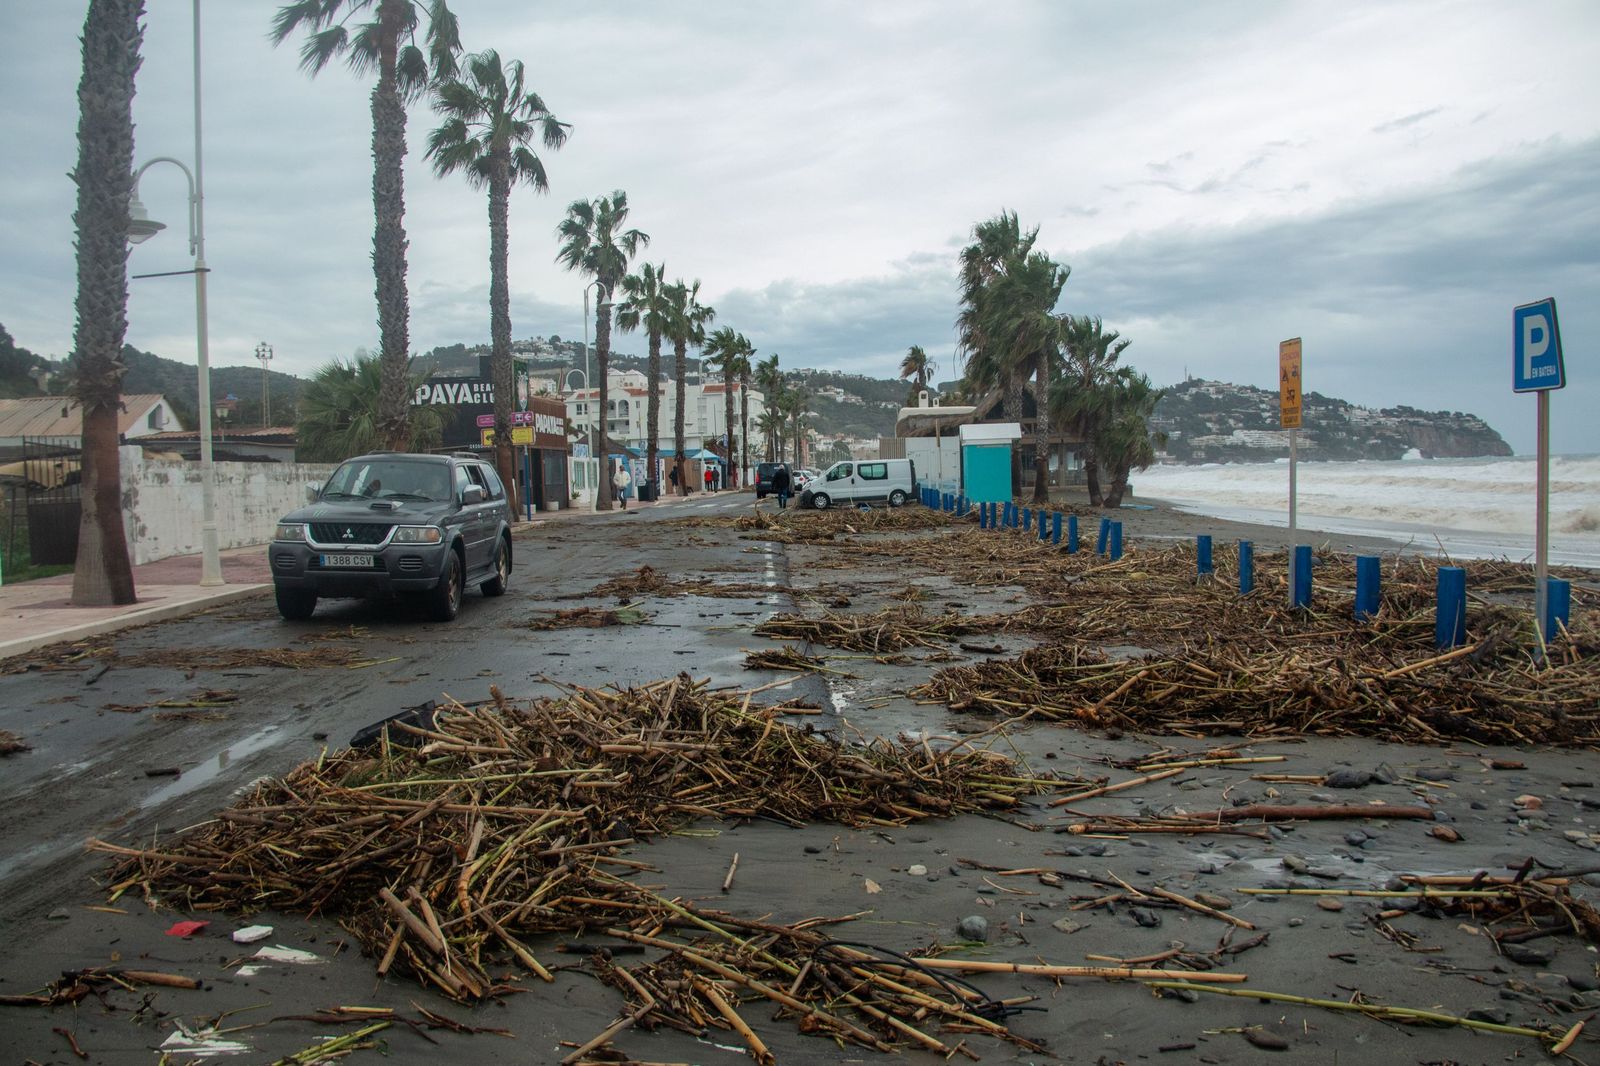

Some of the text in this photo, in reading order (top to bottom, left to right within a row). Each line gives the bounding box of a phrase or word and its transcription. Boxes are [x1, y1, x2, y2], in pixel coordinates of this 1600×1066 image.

[1523, 314, 1550, 380] P
[409, 383, 474, 405] PAYA
[473, 383, 495, 392] BEA
[327, 556, 372, 565] 1388 CSV
